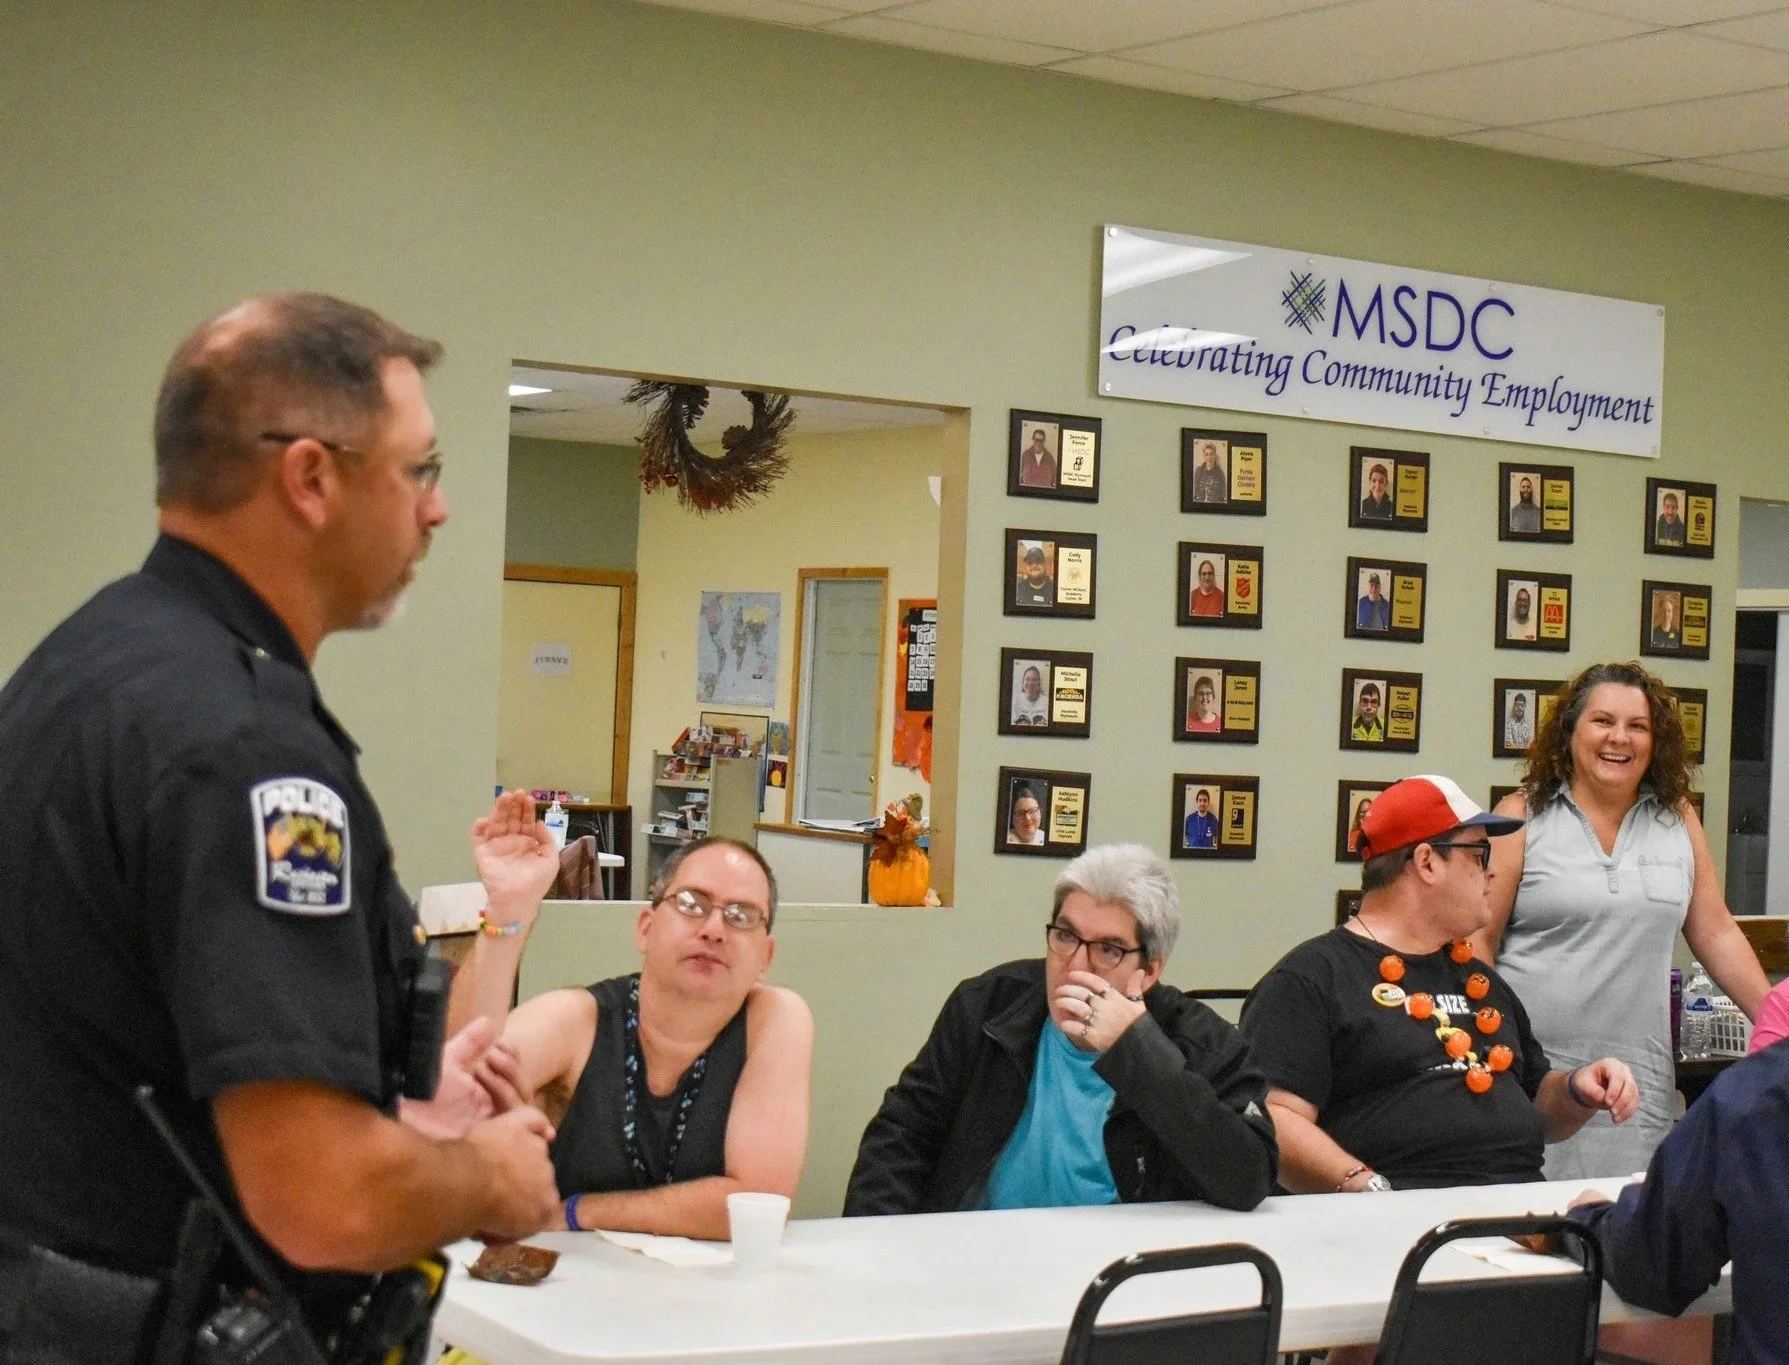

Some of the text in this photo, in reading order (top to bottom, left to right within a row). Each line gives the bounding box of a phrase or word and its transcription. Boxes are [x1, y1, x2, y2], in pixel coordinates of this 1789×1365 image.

[1332, 276, 1516, 360] MSDC
[1108, 324, 1655, 430] Celebrating Community Employment
[262, 784, 344, 828] POLICE
[1436, 993, 1470, 1014] SIZE
